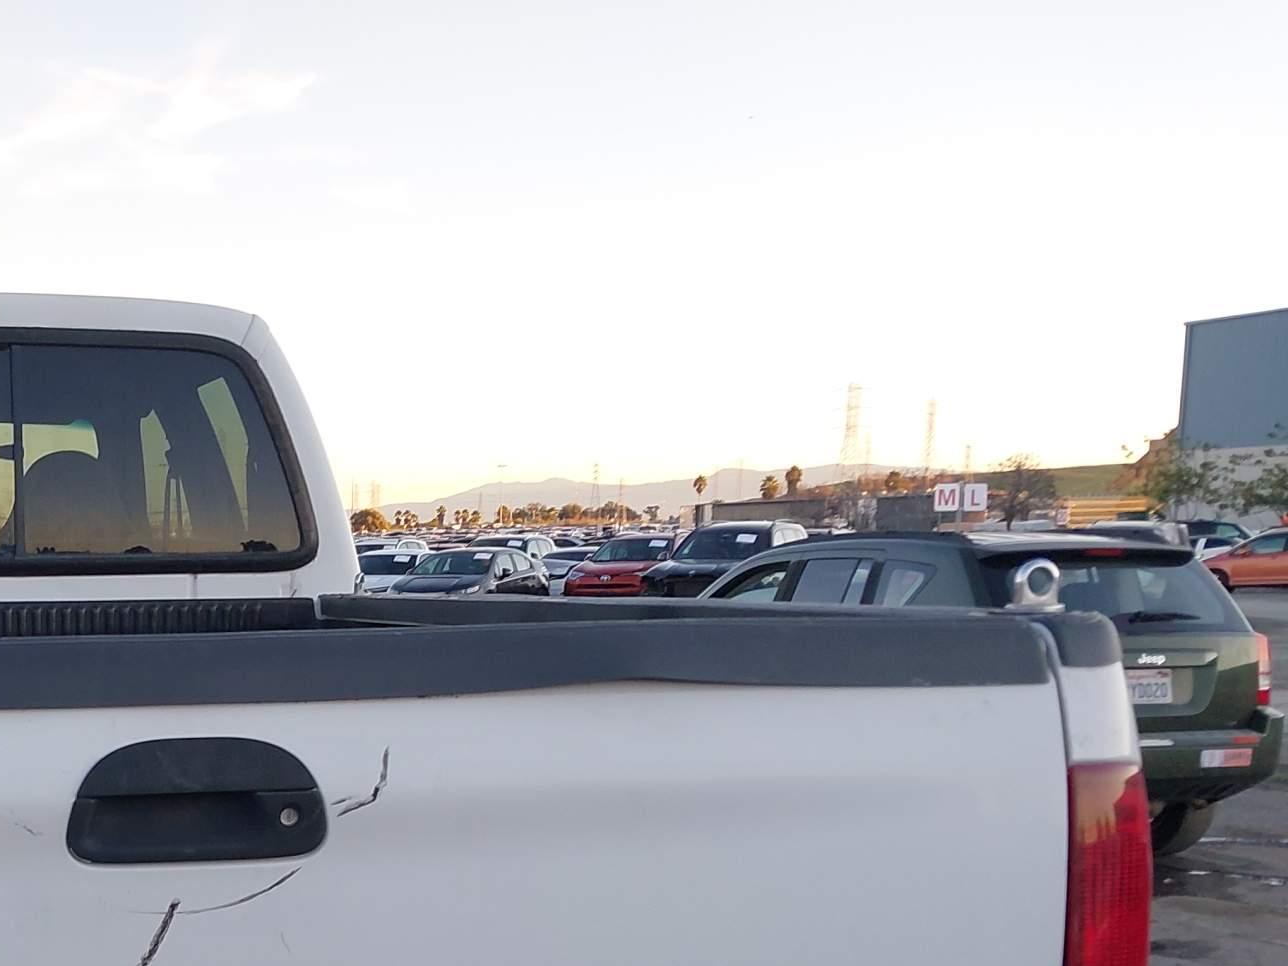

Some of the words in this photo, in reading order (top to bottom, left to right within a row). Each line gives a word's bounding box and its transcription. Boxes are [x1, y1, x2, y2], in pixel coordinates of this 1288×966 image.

[938, 489, 955, 506] M
[971, 490, 981, 506] L
[1137, 653, 1166, 665] Jeep
